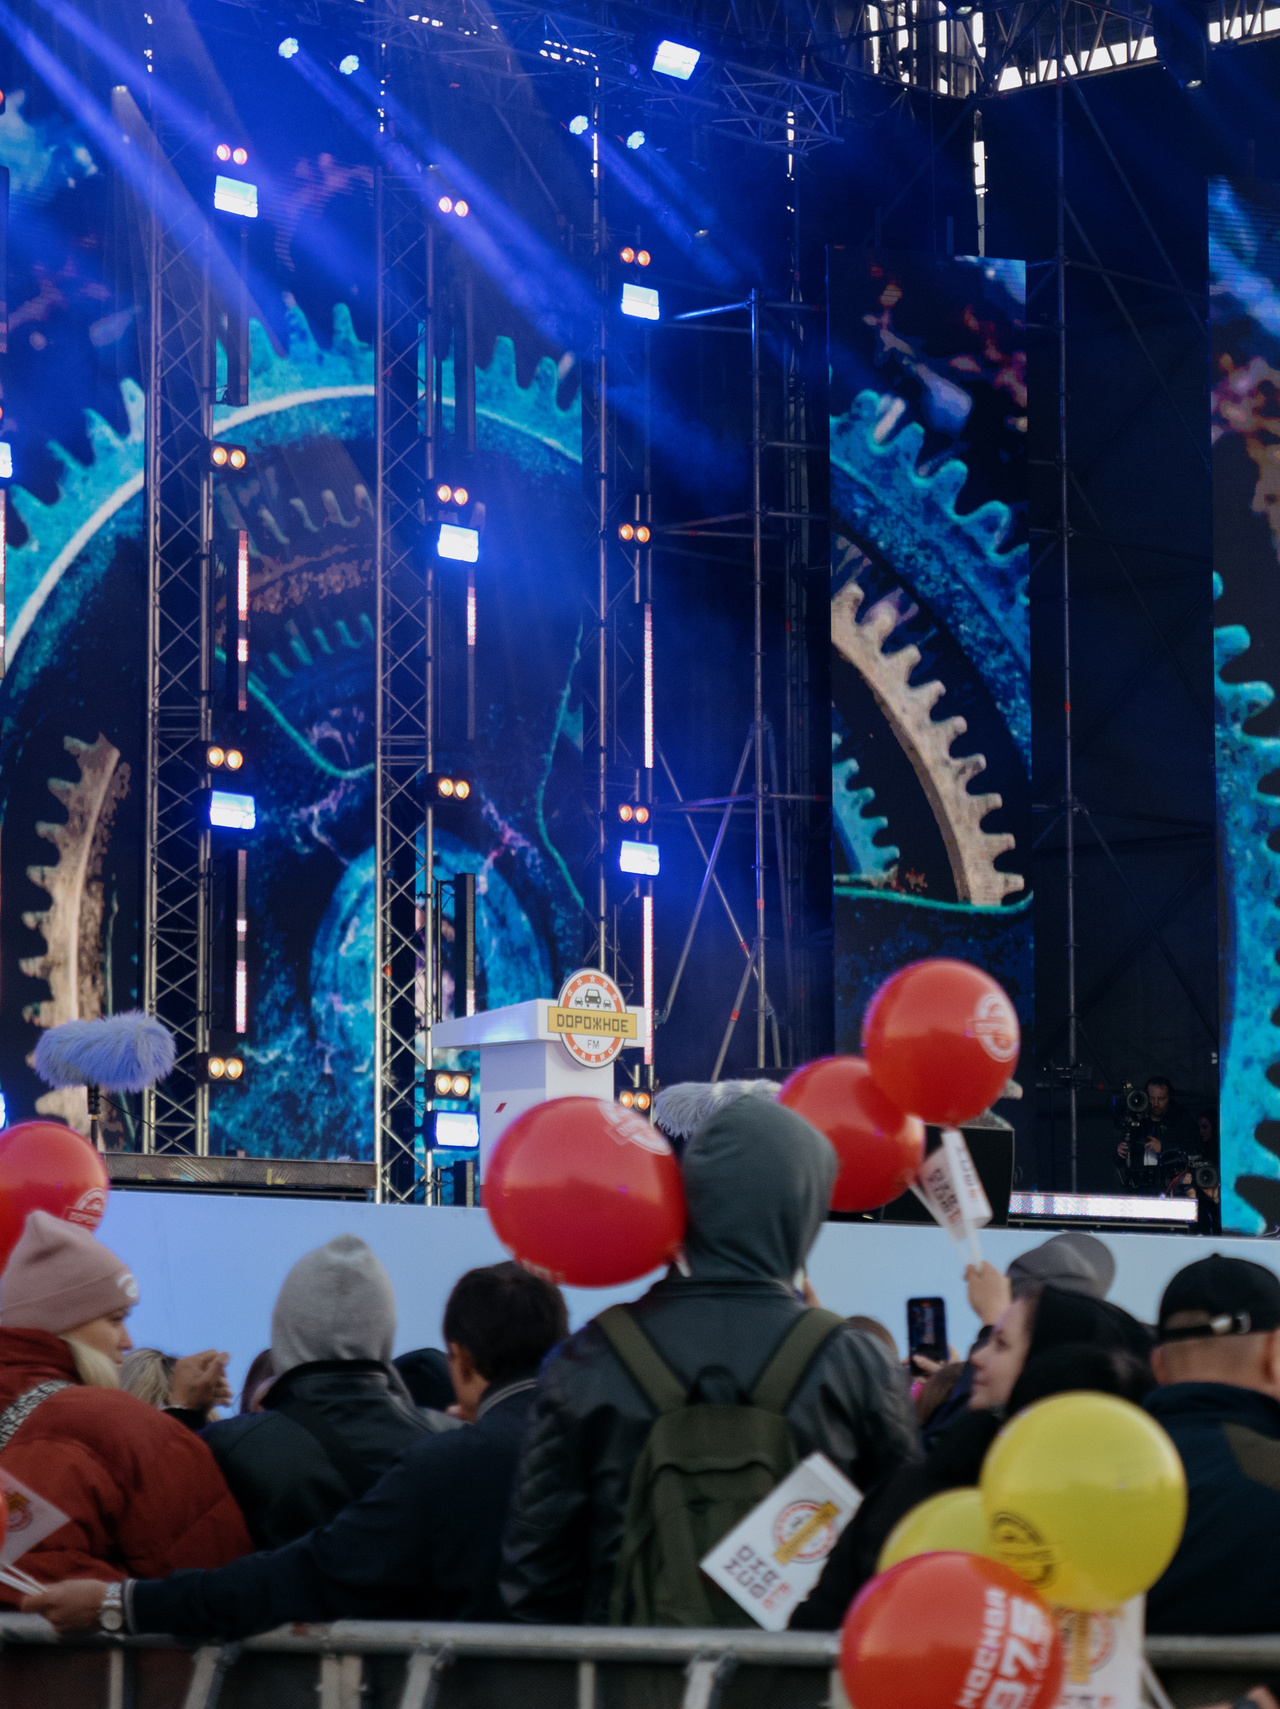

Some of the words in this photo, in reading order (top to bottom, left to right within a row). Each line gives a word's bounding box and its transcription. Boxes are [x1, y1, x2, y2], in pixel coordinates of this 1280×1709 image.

[556, 1014, 628, 1033] ДОРОЖНОЕ
[587, 1039, 600, 1050] FM
[573, 1045, 614, 1062] РАДИО
